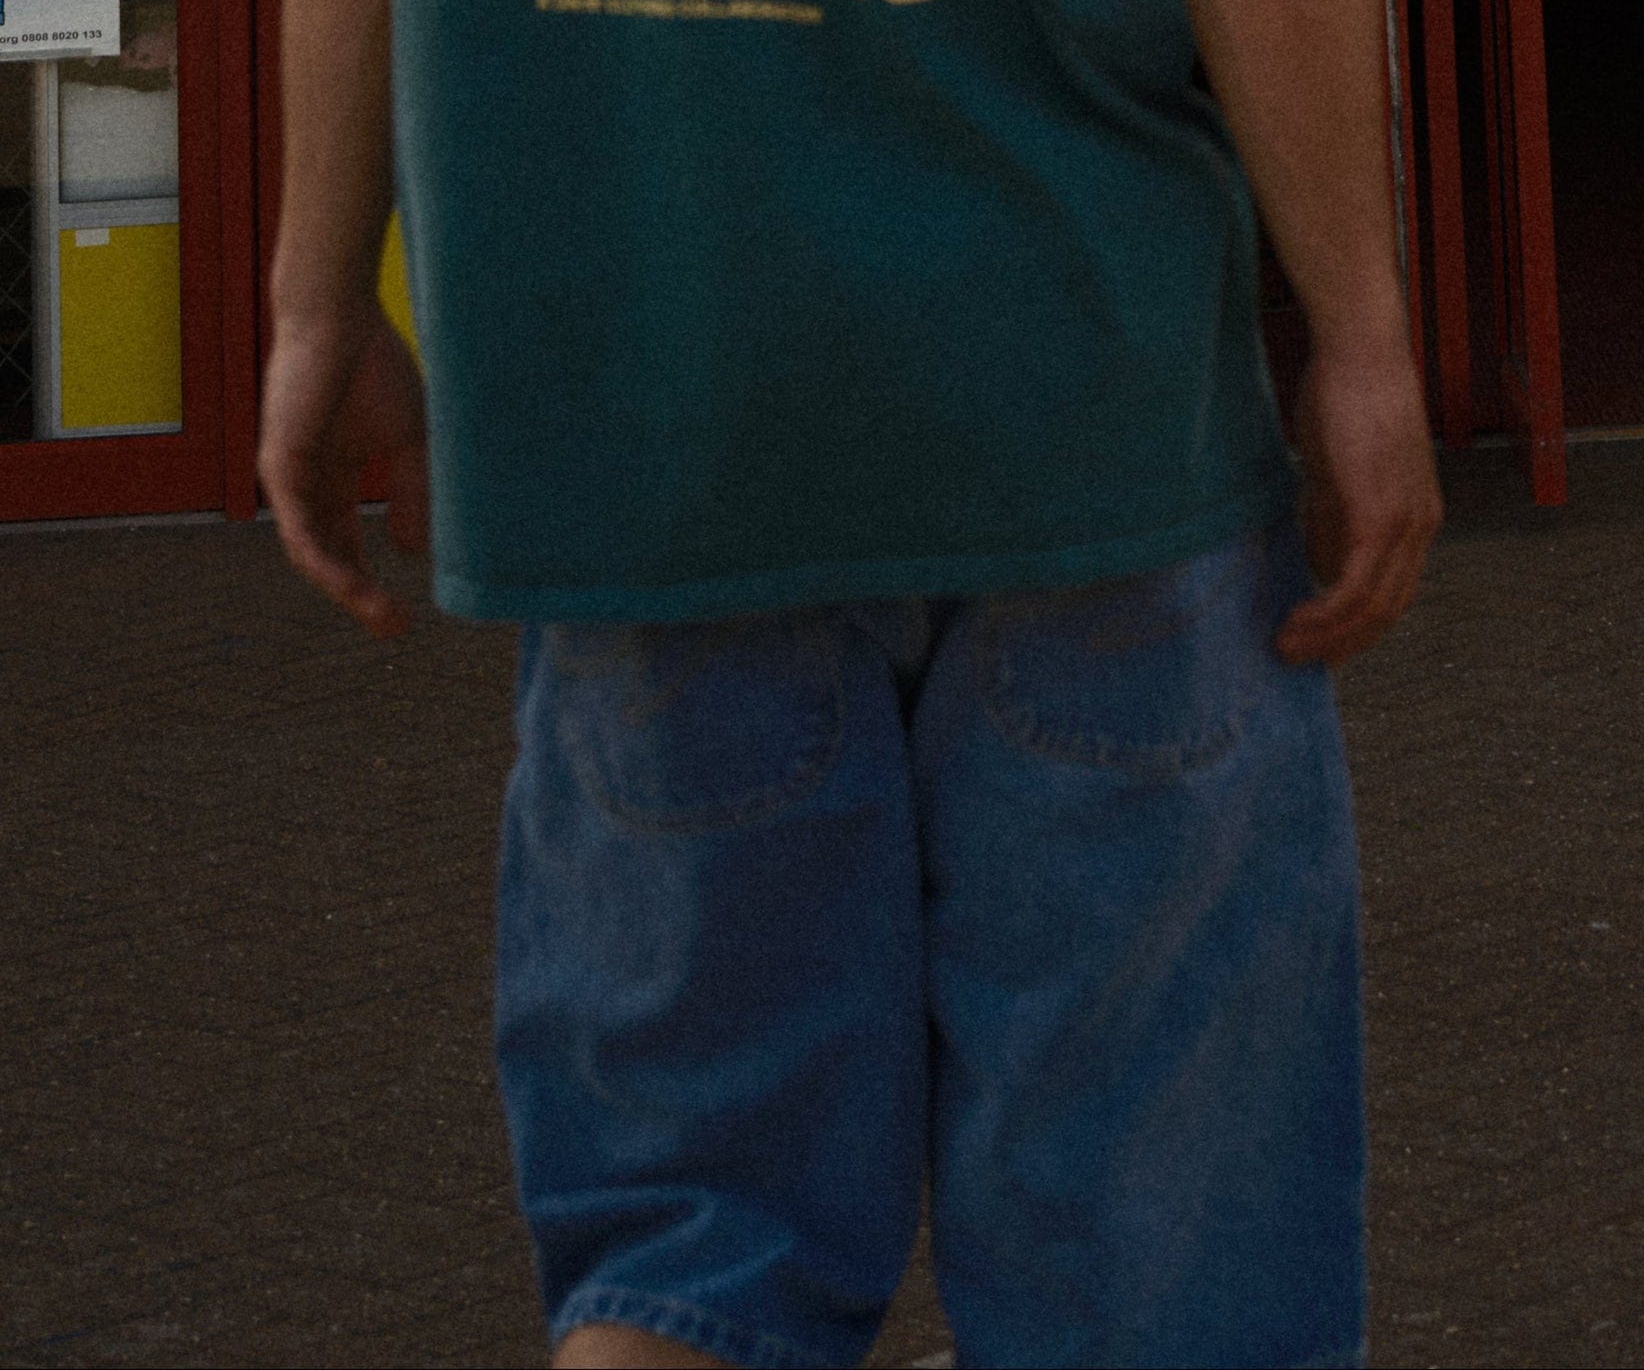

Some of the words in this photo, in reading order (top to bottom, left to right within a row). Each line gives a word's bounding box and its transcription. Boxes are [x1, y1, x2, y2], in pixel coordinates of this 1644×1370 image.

[21, 32, 49, 43] 0808
[52, 30, 79, 42] 8020
[82, 29, 103, 39] 133
